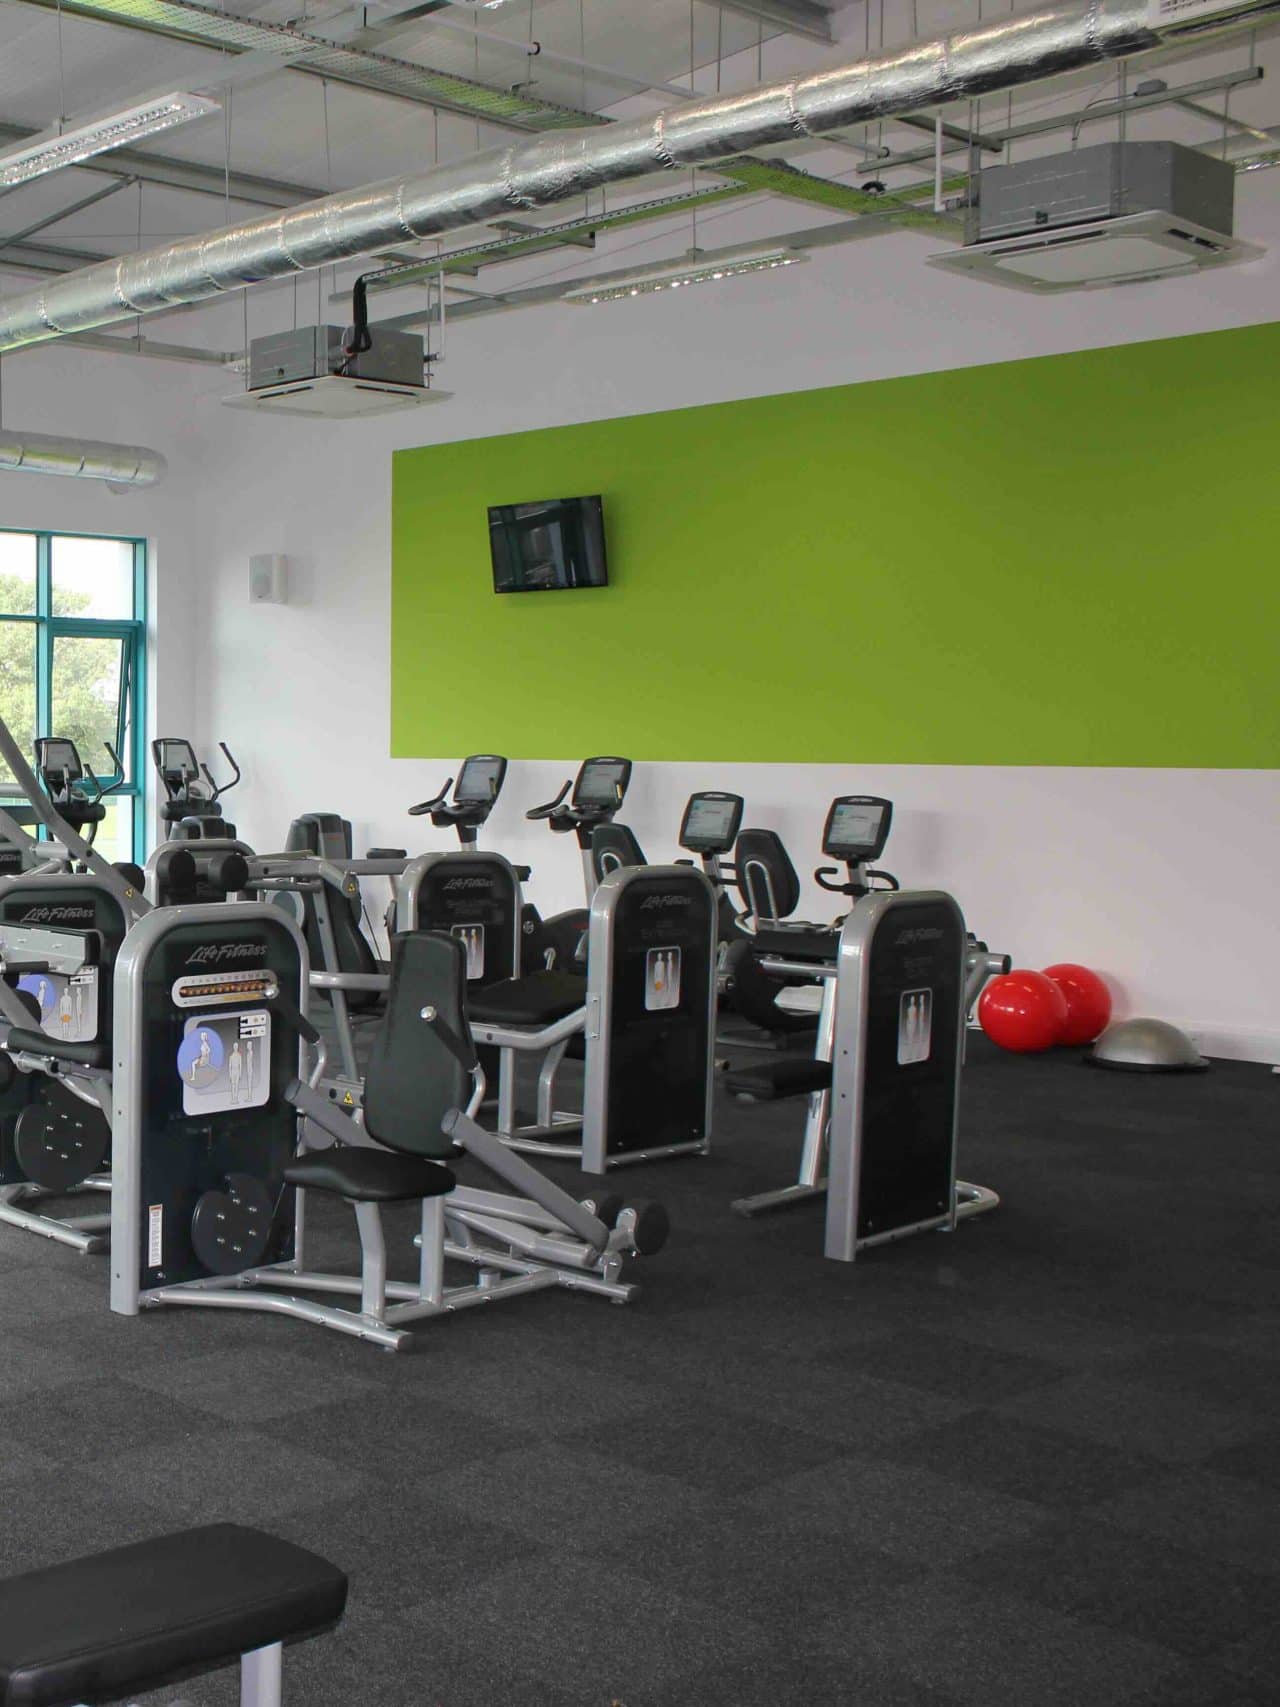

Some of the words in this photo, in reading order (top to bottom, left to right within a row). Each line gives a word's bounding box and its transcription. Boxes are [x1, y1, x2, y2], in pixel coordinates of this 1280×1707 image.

[20, 907, 50, 922] Life
[48, 907, 94, 921] Fitness
[185, 945, 218, 964] Life
[216, 944, 267, 962] Fitness
